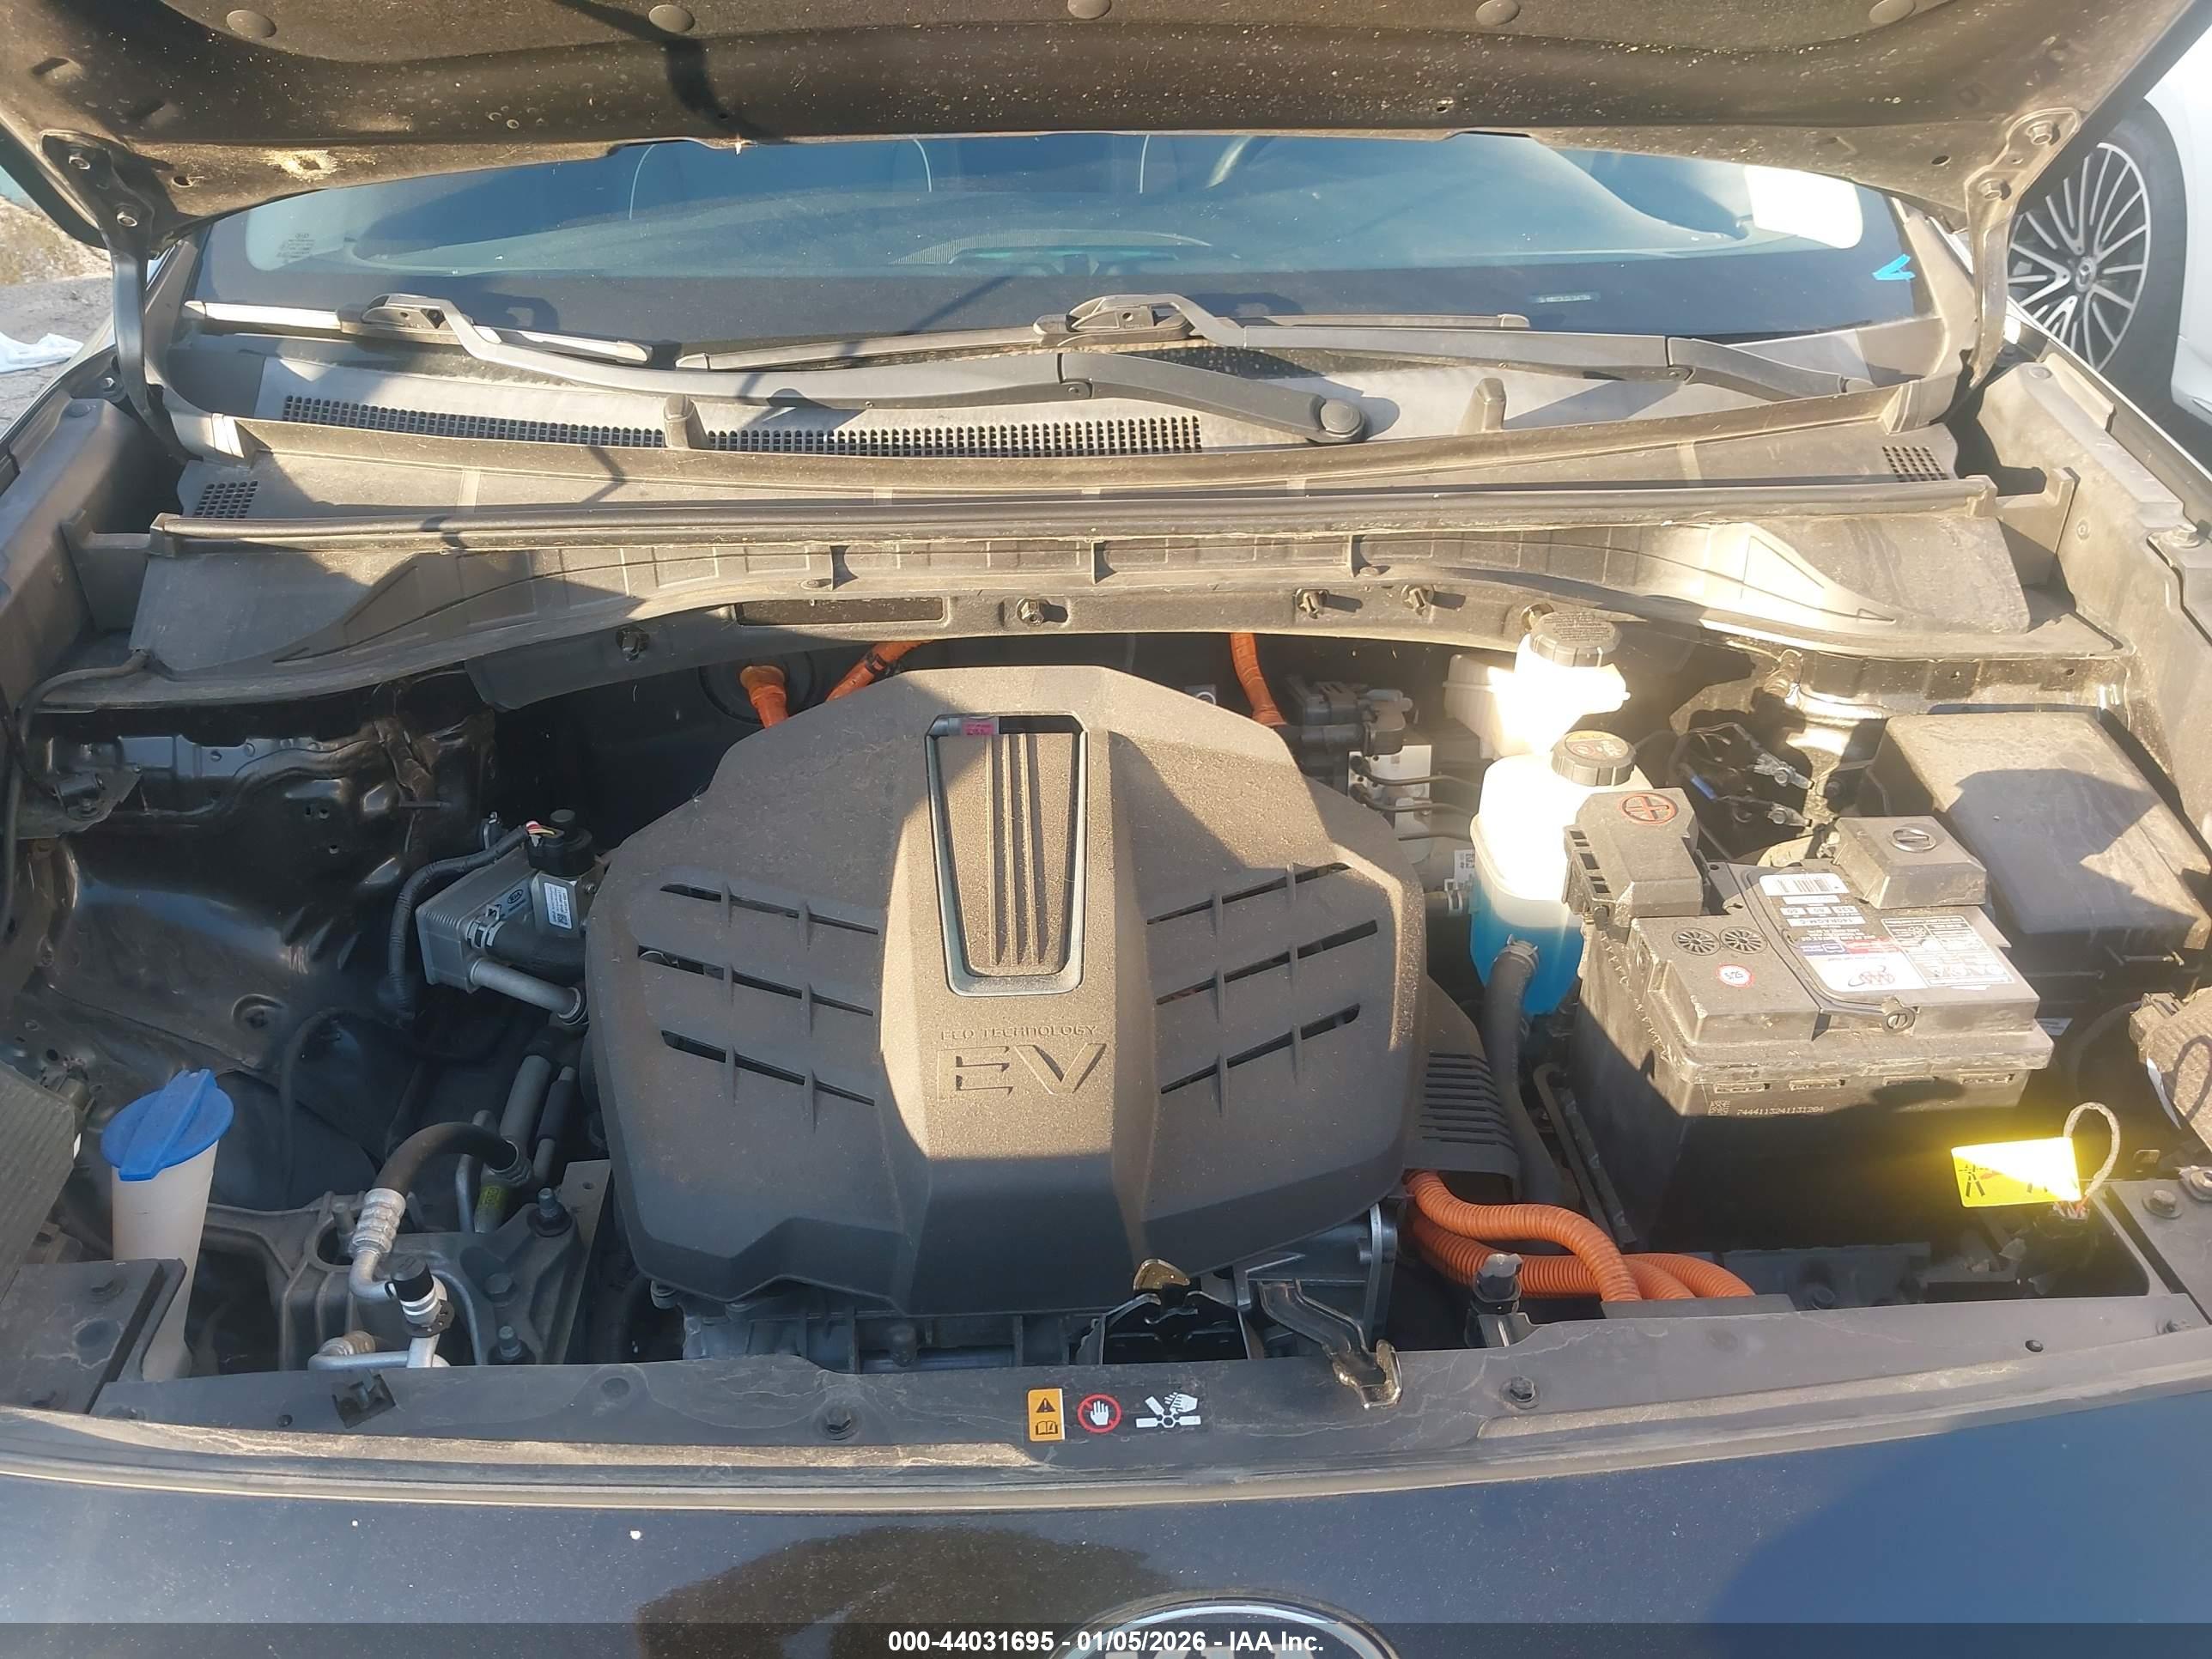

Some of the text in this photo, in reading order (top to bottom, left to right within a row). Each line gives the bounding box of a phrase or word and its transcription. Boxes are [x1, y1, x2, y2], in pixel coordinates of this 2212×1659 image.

[941, 1024, 1097, 1041] ECO TECHNOLOGY
[936, 1043, 1107, 1099] EV
